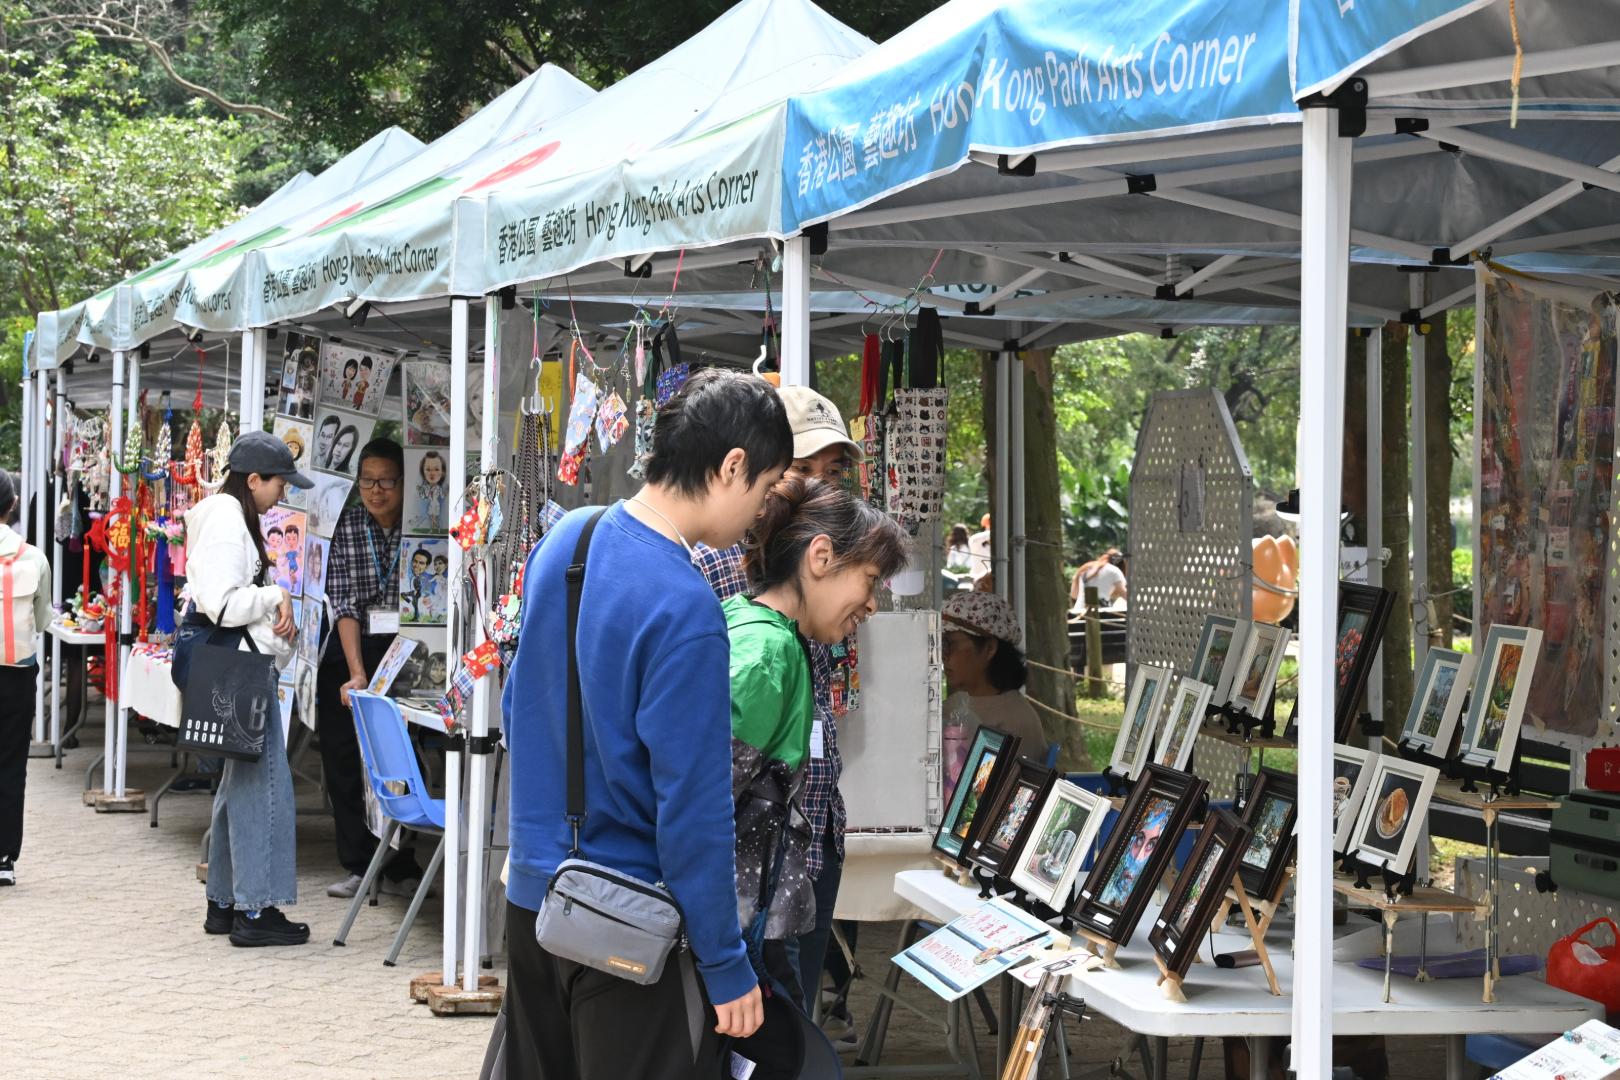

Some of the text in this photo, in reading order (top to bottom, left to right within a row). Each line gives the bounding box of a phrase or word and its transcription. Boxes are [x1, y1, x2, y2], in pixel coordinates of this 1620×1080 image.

[798, 31, 1257, 196] 香港公園 藝趣坊 Hon Kong Park Arts Corner
[498, 169, 759, 265] 香港公園 藝趣坊 Hong Kong Park Arts Corner
[322, 254, 349, 286] Hong
[384, 241, 403, 275] Arts
[404, 242, 439, 274] Corner
[109, 520, 131, 549] 福
[185, 730, 224, 745] BROWN
[187, 718, 224, 734] BOBBI
